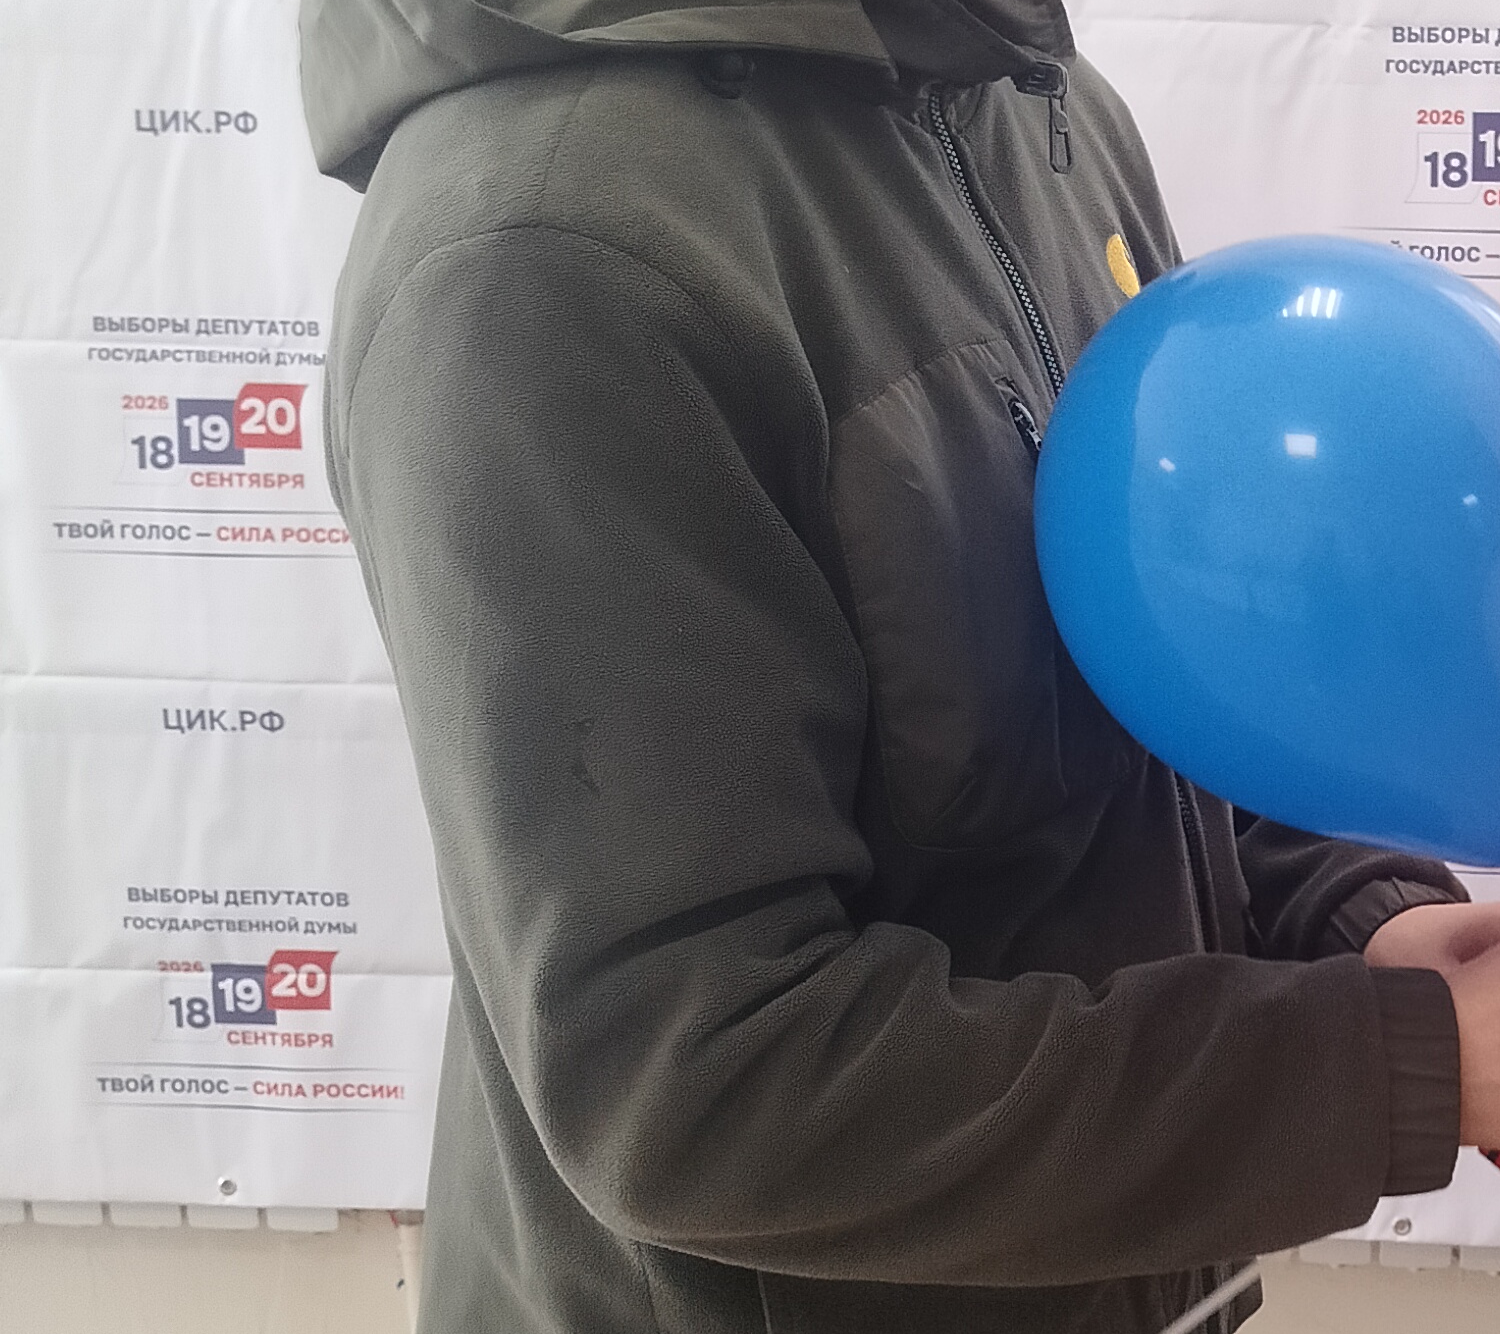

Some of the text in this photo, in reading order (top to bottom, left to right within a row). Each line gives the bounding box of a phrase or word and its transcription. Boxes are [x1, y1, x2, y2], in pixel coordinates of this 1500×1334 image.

[1393, 27, 1489, 44] ВЫБОРЫ
[135, 109, 258, 135] ЦИК.РФ
[1417, 109, 1465, 125] 2026
[1424, 151, 1468, 188] 18
[93, 316, 319, 337] ВЫБОРЫ ДЕПУТАТОВ
[88, 347, 326, 366] ГОСУДАРСТВЕННОЙ ДУМЫ
[122, 395, 169, 410] 2026
[131, 398, 296, 469] 18 19 20
[190, 471, 305, 489] СЕНТЯБРЯ
[54, 520, 114, 540] ТВОЙ
[120, 523, 191, 541] ГОЛОС
[217, 526, 276, 543] СИЛА
[162, 708, 284, 734] ЦИК.РФ
[127, 887, 350, 907] ВЫБОРЫ ДЕПУТАТОВ
[123, 916, 357, 935] ГОСУДАРСТВЕННОЙ ДУМЫ
[169, 963, 326, 1029] 18 19 20
[227, 1030, 334, 1048] СЕНТЯБРЯ
[97, 1074, 154, 1093] ТВОЙ
[160, 1078, 229, 1094] ГОЛОС
[253, 1081, 307, 1098] СИЛА
[312, 1083, 405, 1100] РОССИИ!
